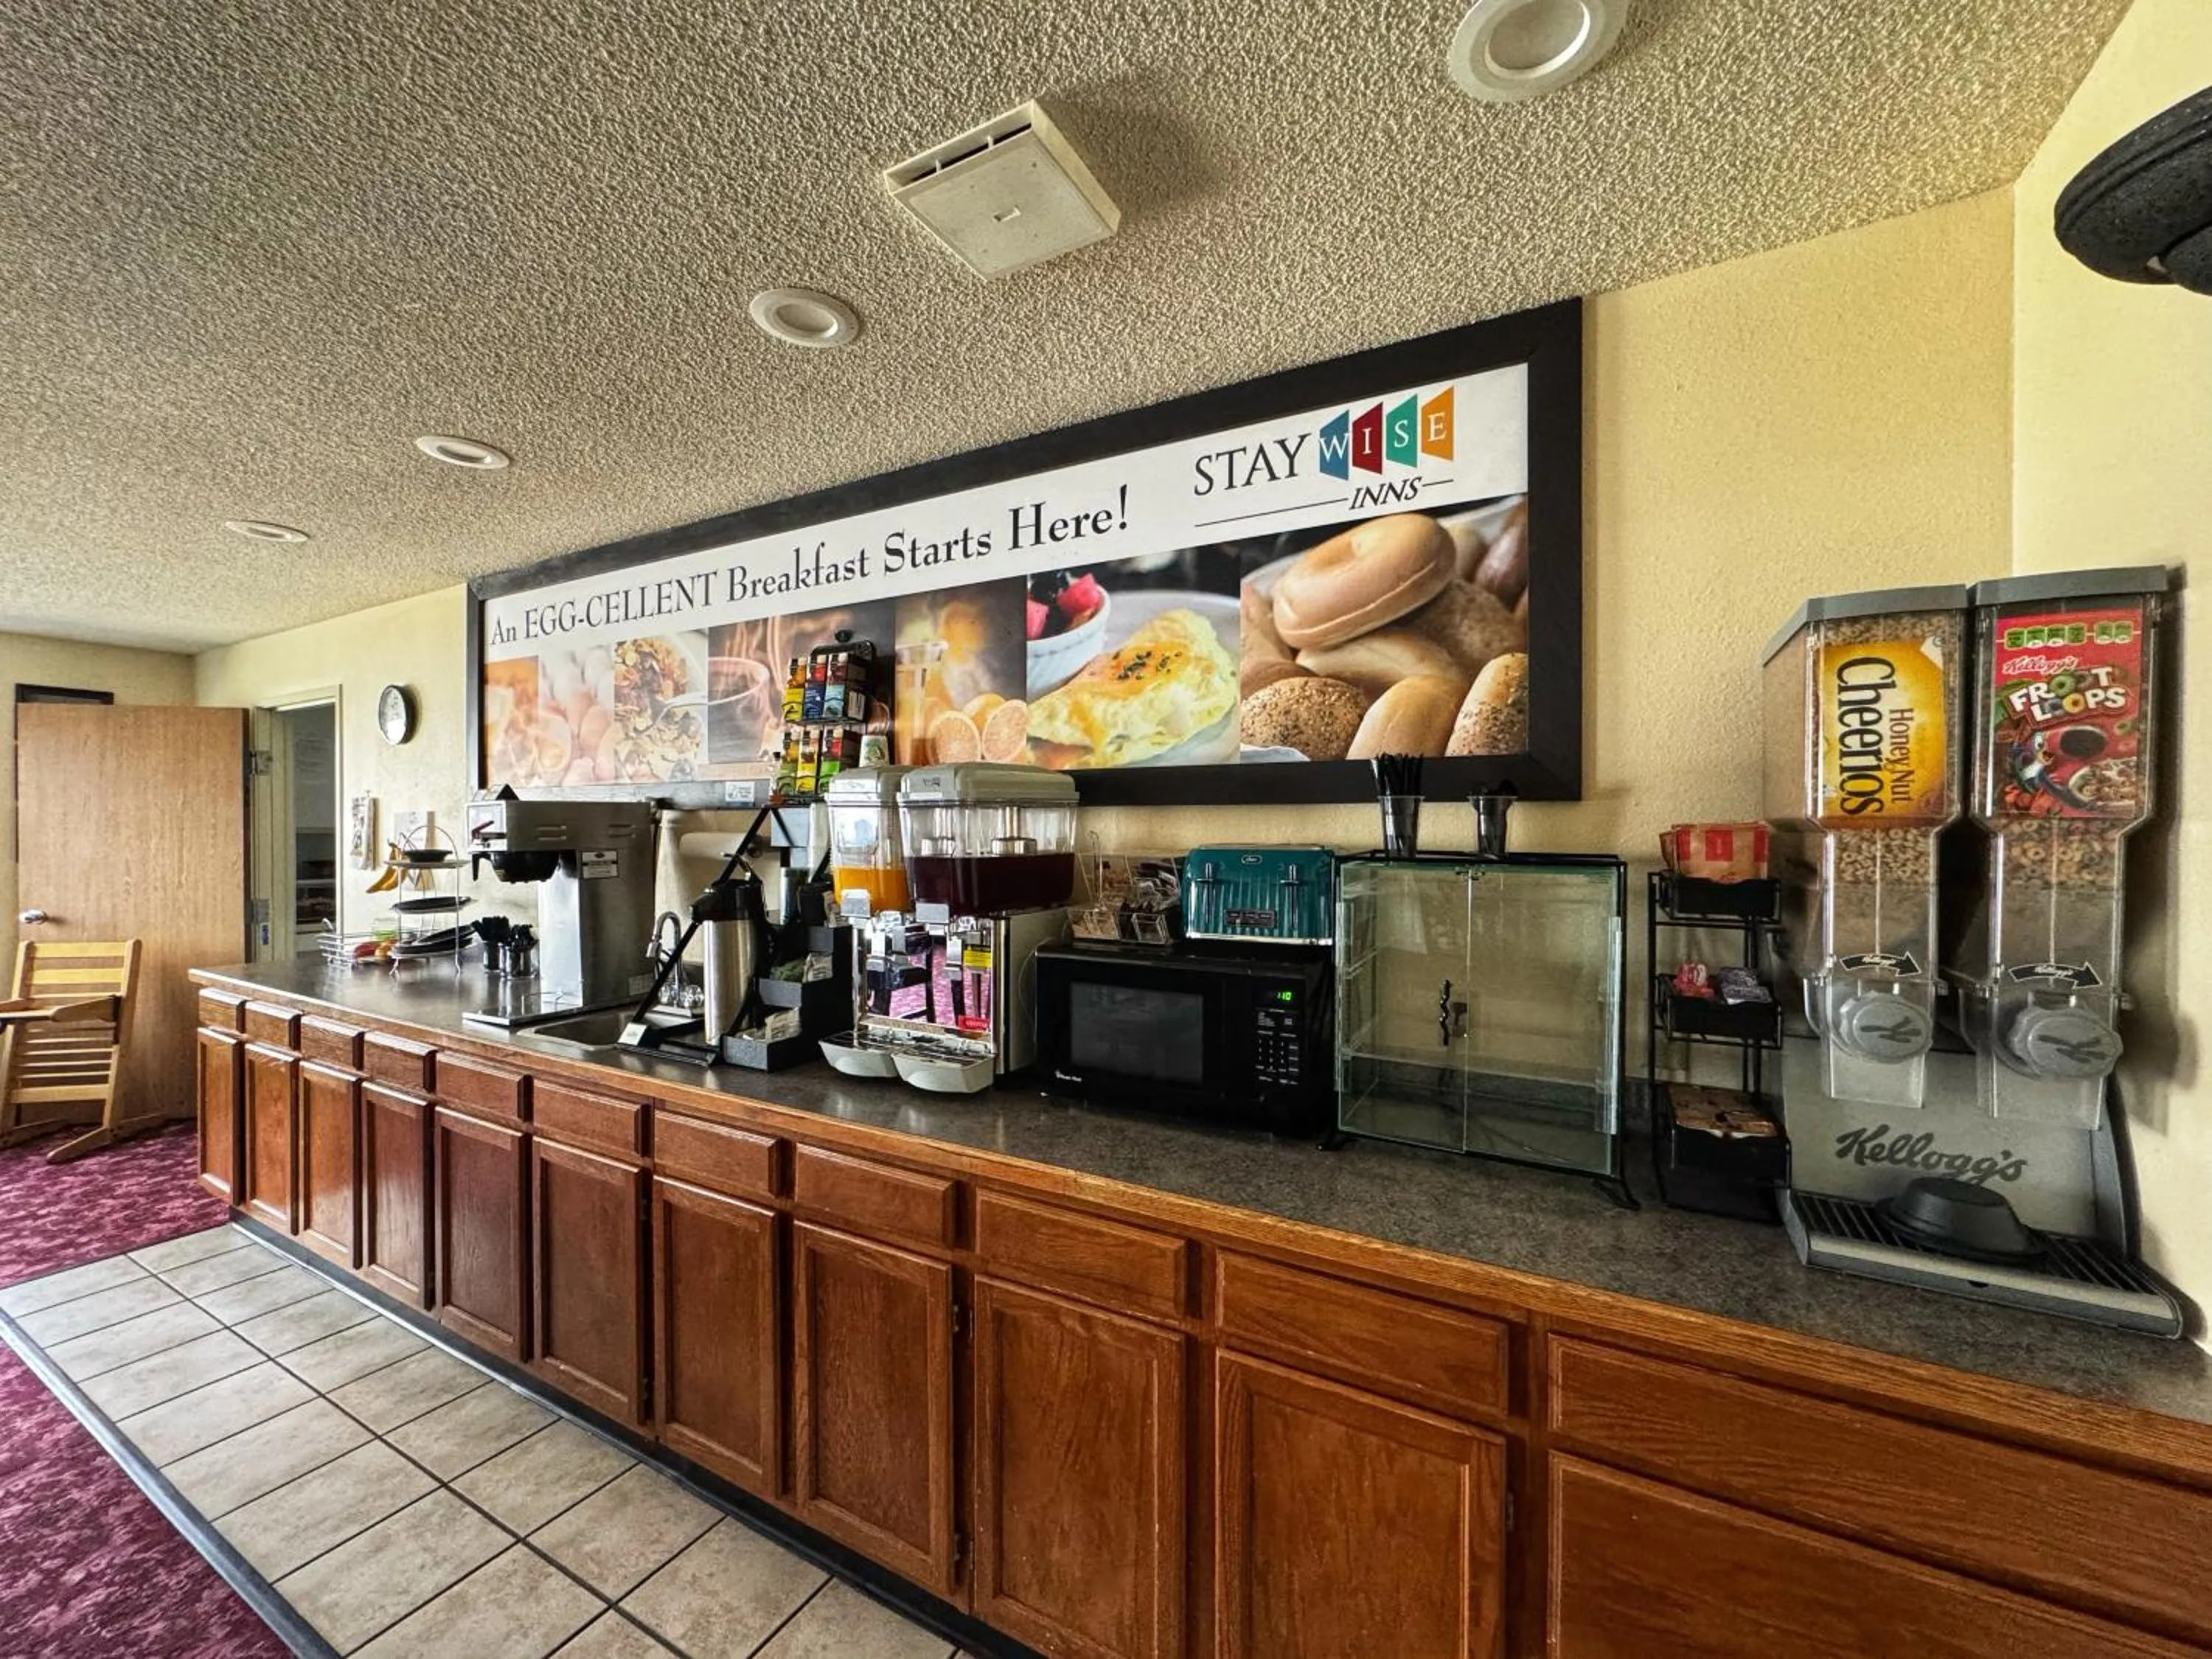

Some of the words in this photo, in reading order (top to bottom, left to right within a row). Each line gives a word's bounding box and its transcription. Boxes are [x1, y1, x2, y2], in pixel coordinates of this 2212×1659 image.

[1193, 432, 1312, 496] STAY
[1349, 476, 1422, 510] INNS
[490, 613, 517, 645] An
[524, 571, 717, 639] EGG-CELLENT
[728, 541, 870, 603] Breakfast
[884, 526, 992, 573] Starts
[1007, 483, 1129, 551] Here!
[1837, 656, 1897, 815] Cheerios
[1885, 707, 1914, 770] Honey
[1889, 769, 1916, 804] Nut
[1835, 1124, 2027, 1186] Kellogg's
